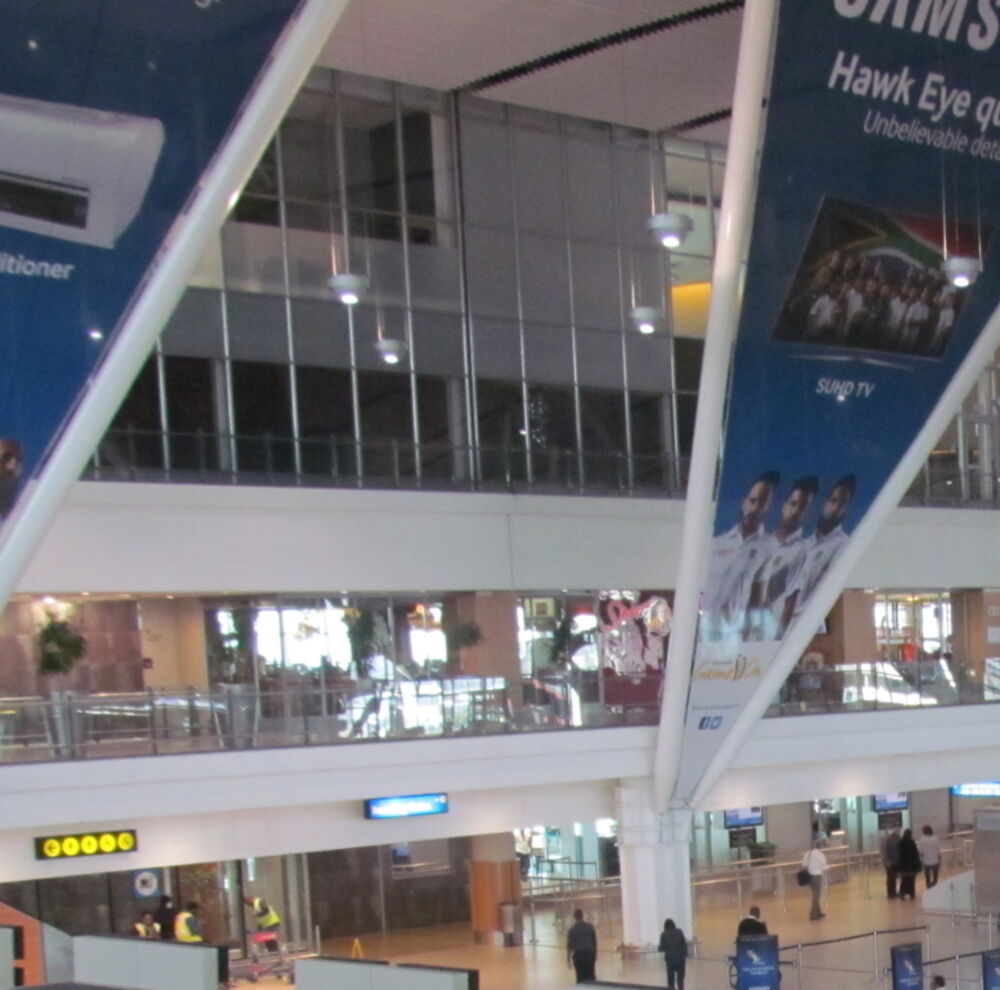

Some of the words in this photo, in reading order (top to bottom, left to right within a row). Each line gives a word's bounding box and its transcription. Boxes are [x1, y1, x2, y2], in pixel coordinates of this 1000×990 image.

[828, 51, 915, 105] Hawk
[918, 72, 971, 122] Eye
[863, 109, 968, 152] Unbelievable
[0, 252, 75, 279] itioner
[816, 378, 854, 396] SUHD
[856, 382, 876, 397] TV
